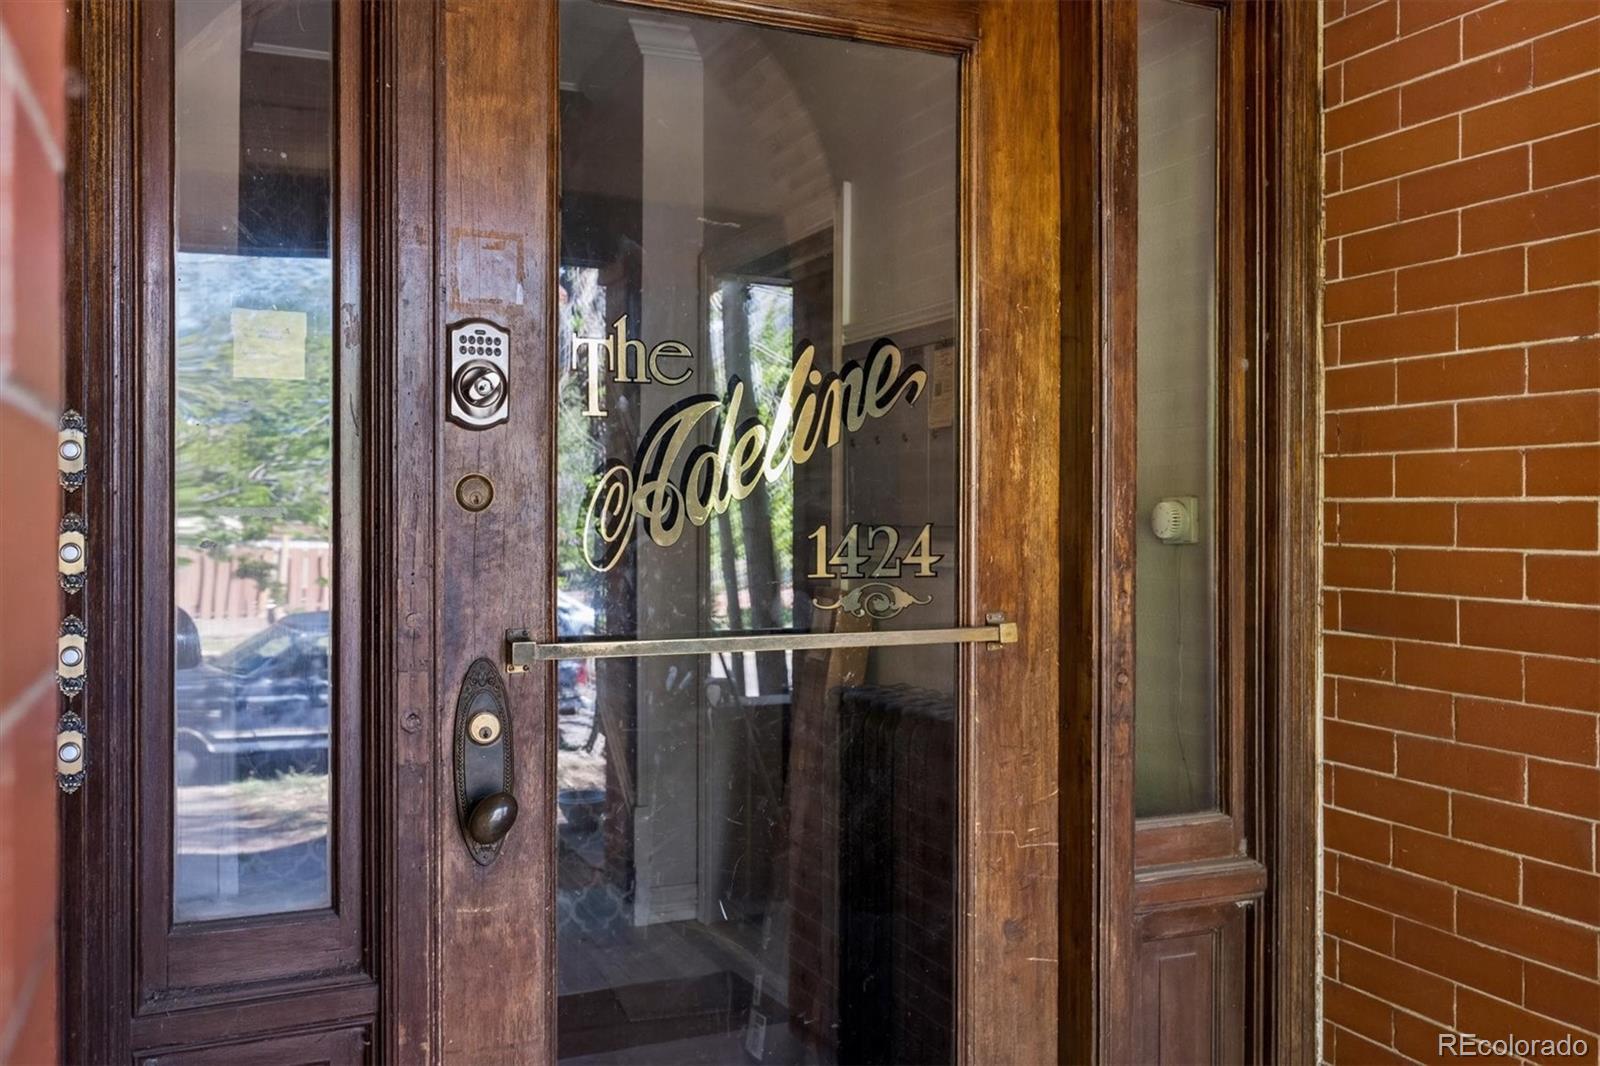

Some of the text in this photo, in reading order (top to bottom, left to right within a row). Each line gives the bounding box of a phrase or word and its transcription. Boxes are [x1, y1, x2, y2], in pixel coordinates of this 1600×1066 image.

[571, 313, 694, 417] The
[581, 338, 928, 572] Adeline
[807, 523, 944, 579] 1424
